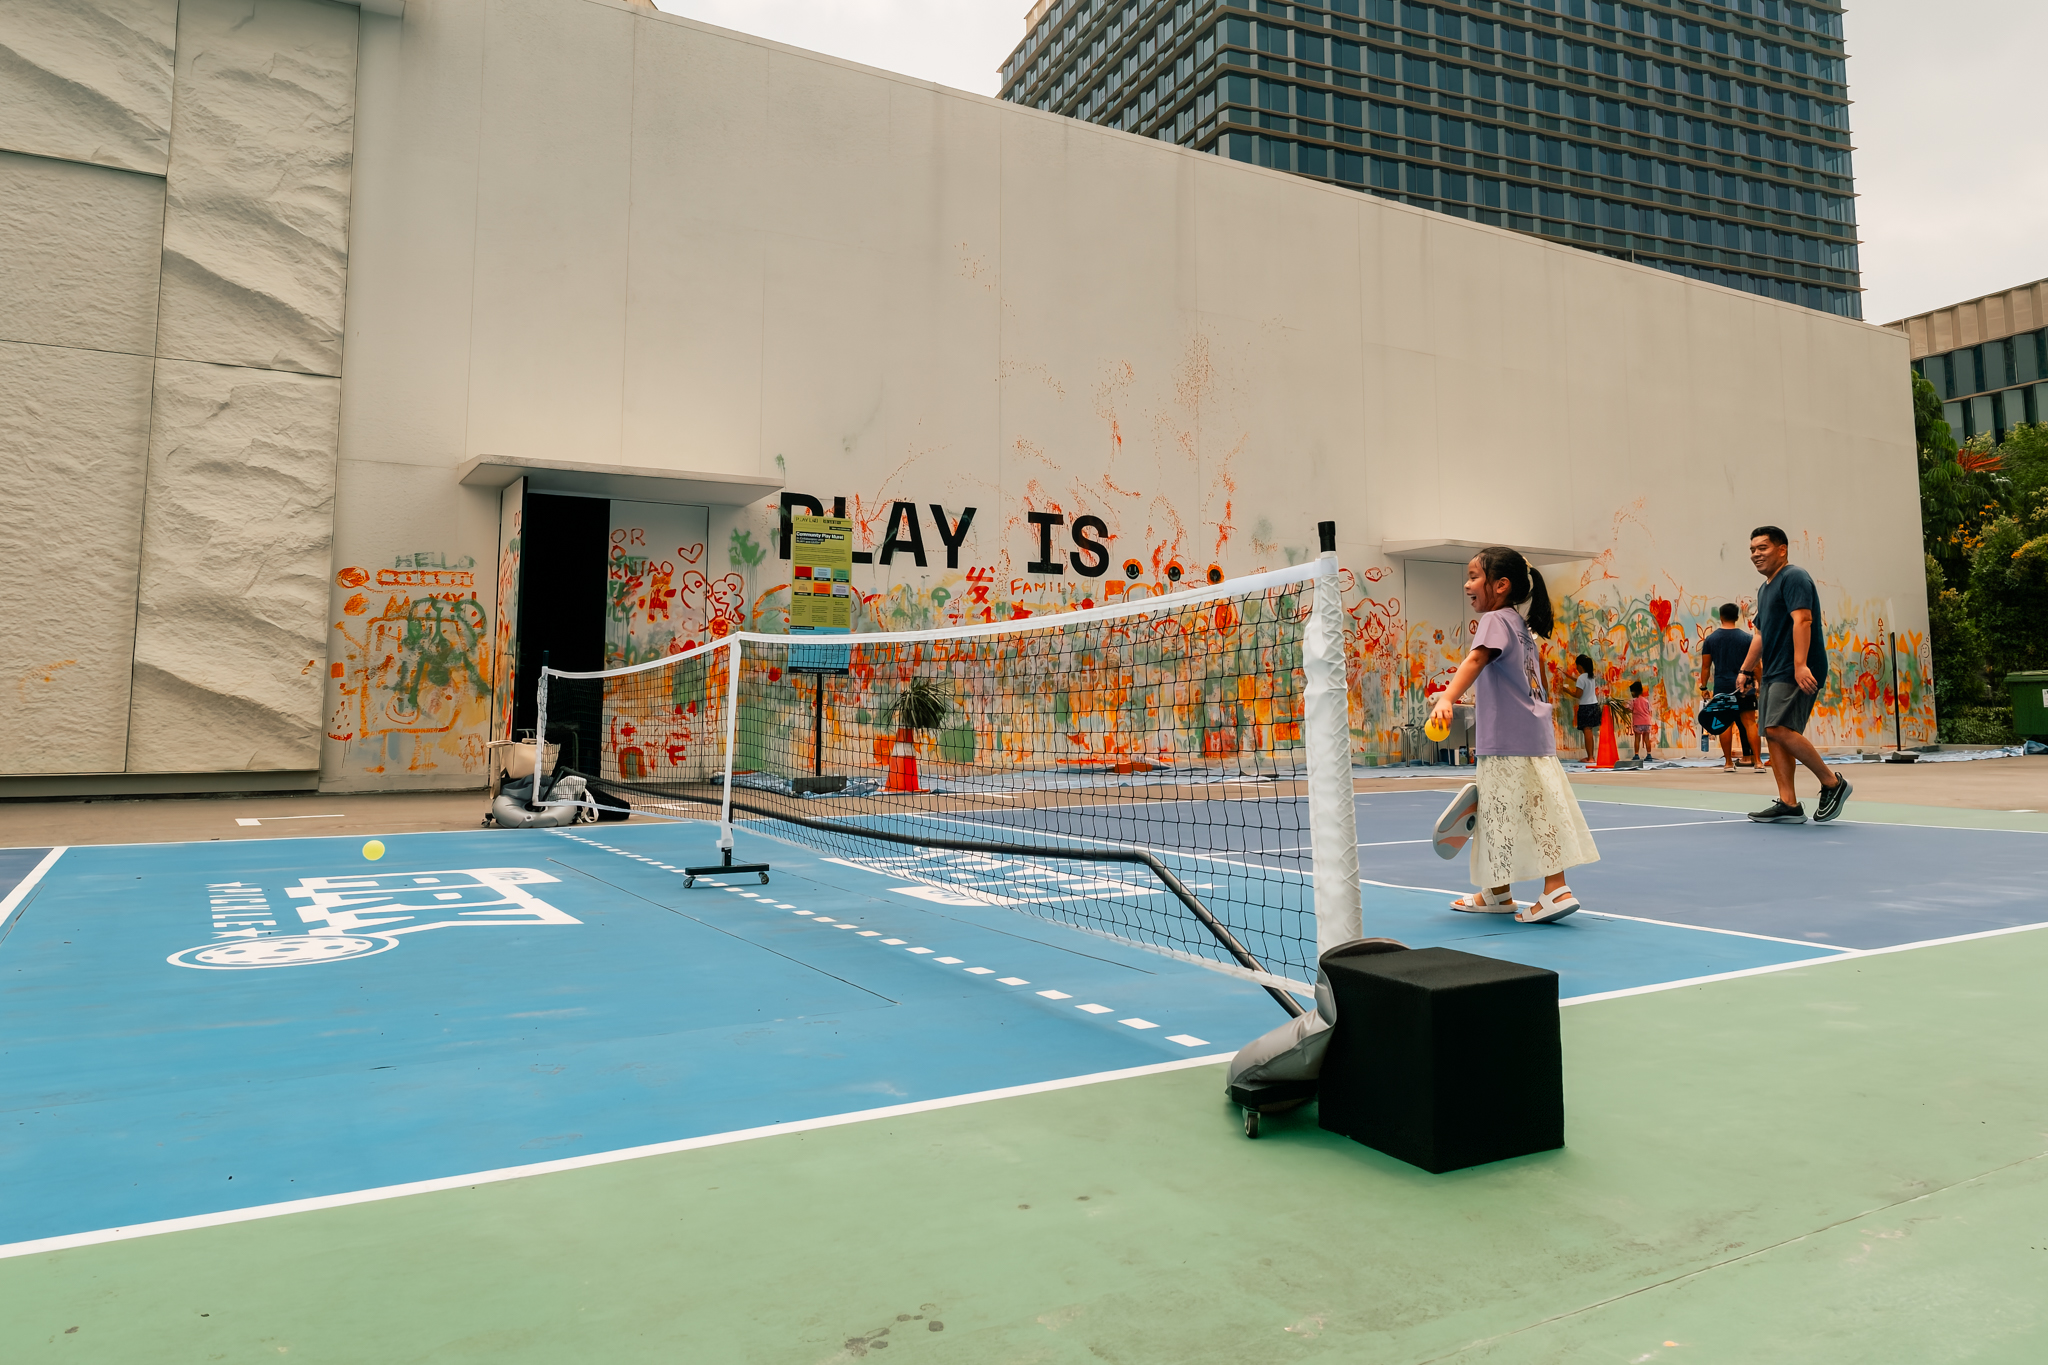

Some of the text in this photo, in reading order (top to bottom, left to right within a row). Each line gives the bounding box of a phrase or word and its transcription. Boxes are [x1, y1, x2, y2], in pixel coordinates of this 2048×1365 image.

[779, 491, 978, 570] PLAY
[796, 531, 822, 539] Community
[395, 551, 478, 570] HELLO
[1010, 577, 1077, 596] FAMILY
[207, 887, 278, 928] PICKLE
